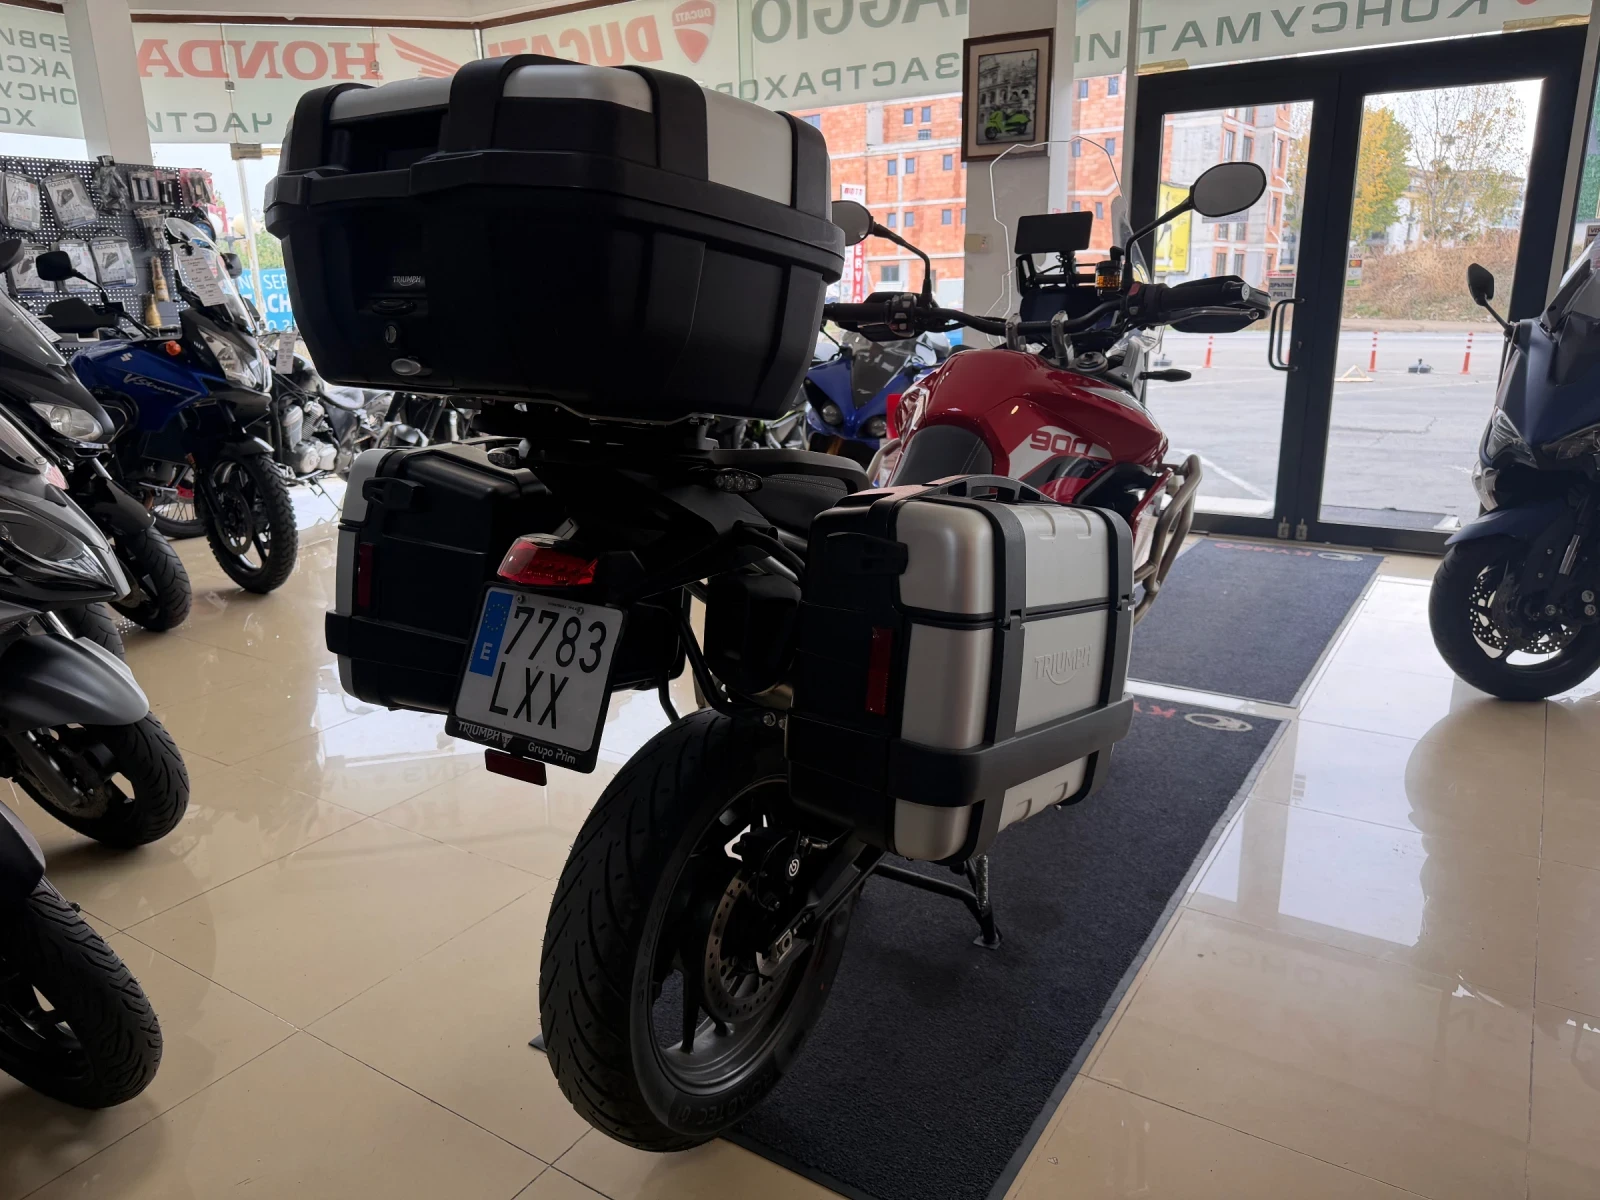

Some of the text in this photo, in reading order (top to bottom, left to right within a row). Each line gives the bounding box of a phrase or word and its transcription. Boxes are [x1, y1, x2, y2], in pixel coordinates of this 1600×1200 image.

[393, 275, 422, 287] TRIUMPH
[1029, 430, 1093, 456] 900
[480, 642, 492, 660] E
[504, 605, 607, 674] 7783
[1033, 644, 1093, 686] TRIUMPH
[488, 661, 570, 730] LXX
[458, 721, 500, 741] TRIUMPH
[527, 742, 576, 764] Grupo Prim
